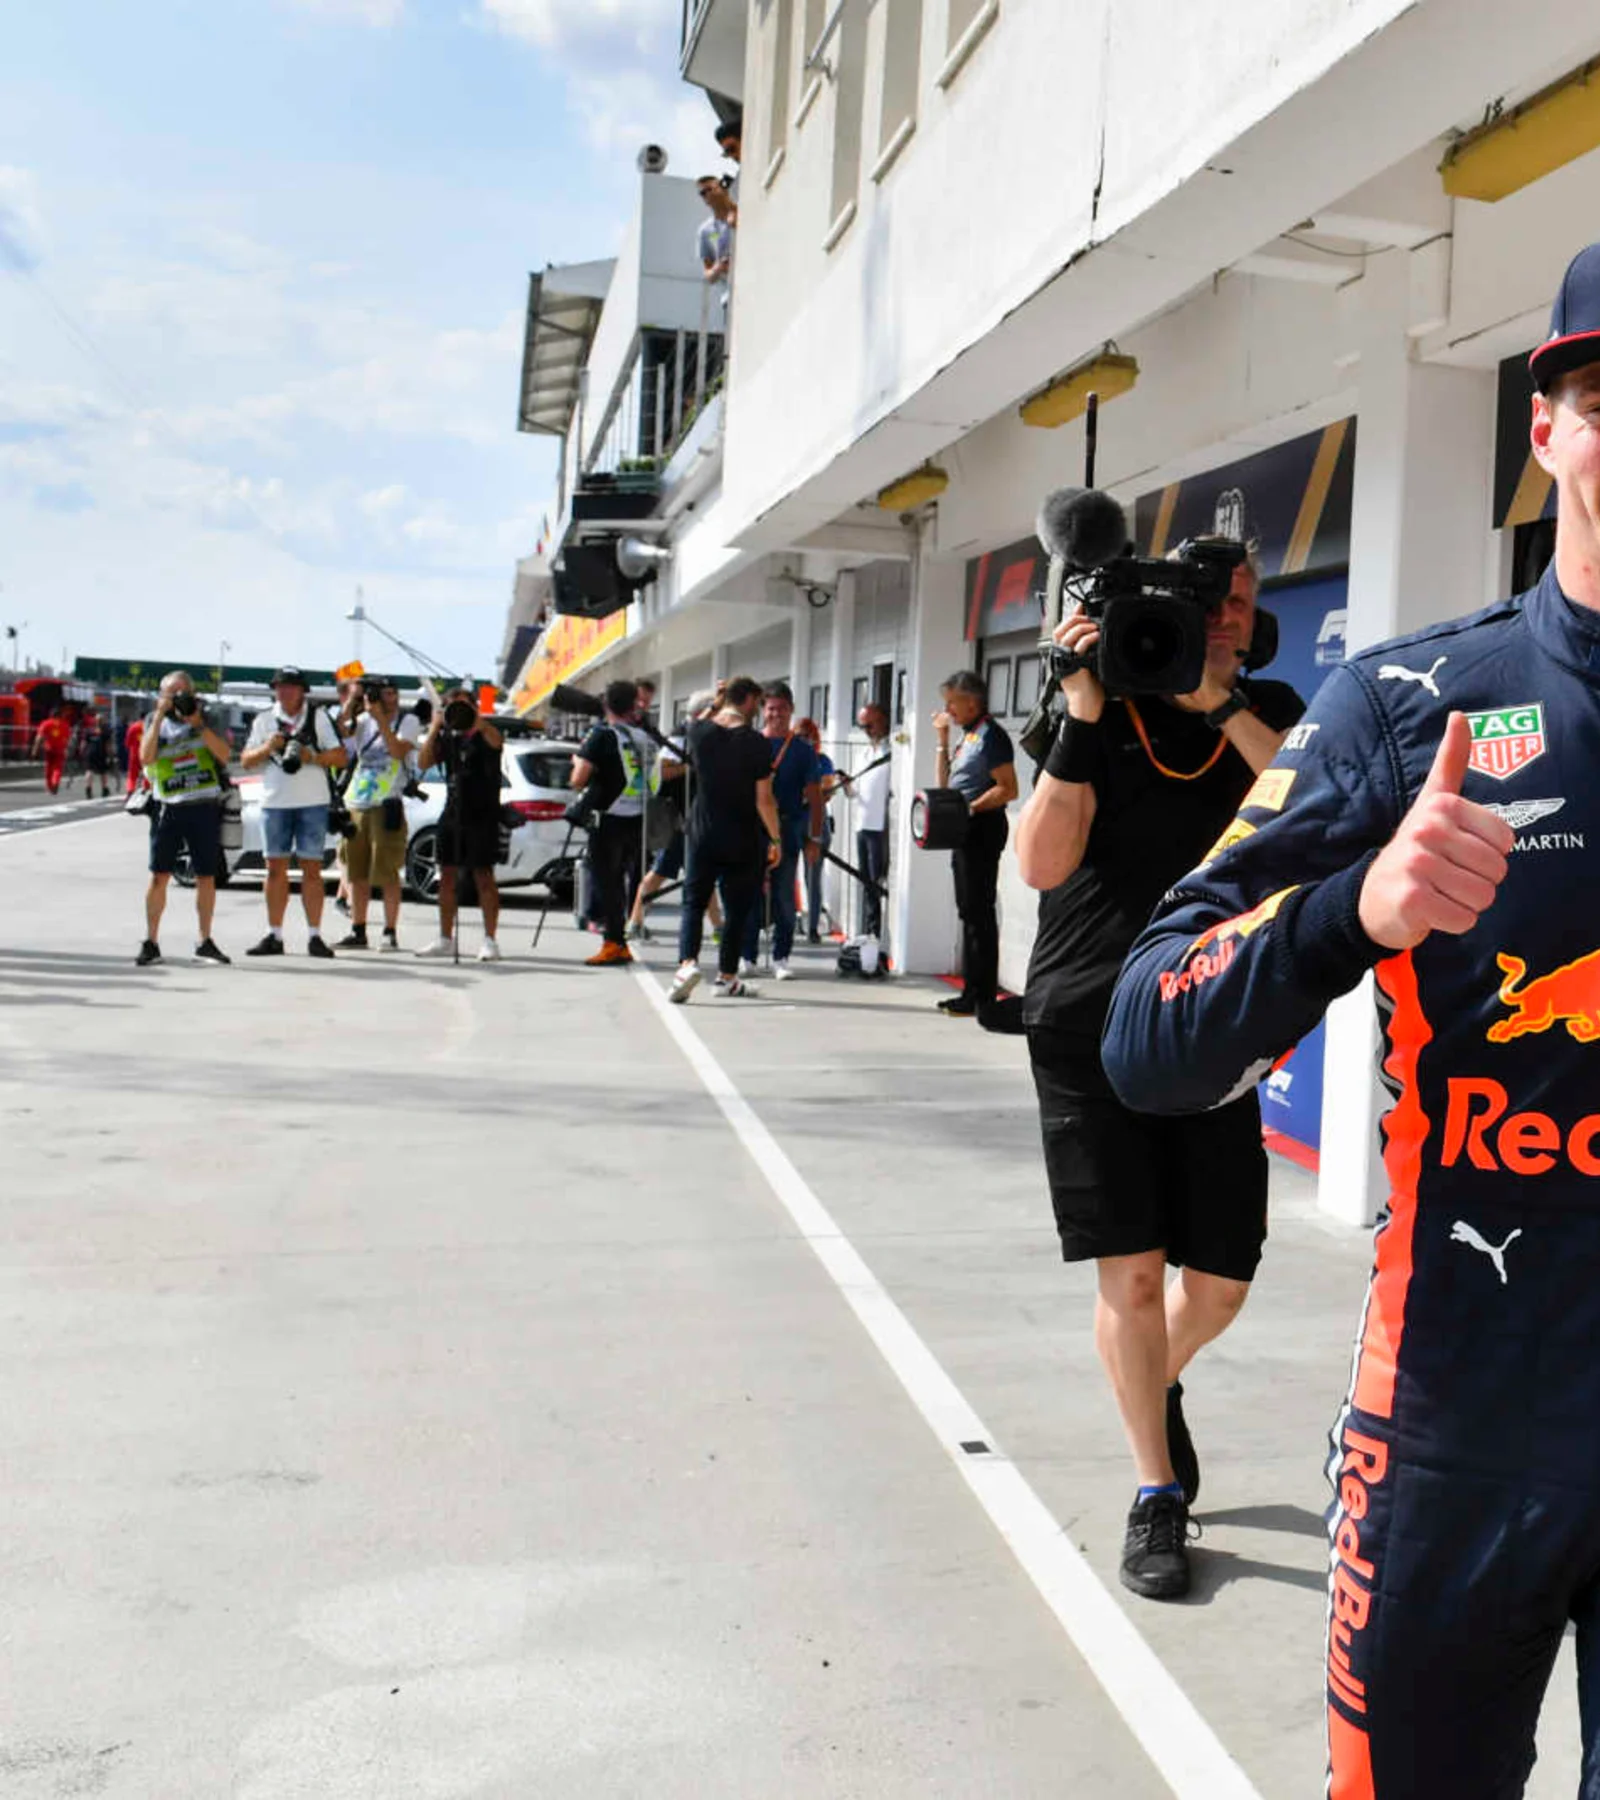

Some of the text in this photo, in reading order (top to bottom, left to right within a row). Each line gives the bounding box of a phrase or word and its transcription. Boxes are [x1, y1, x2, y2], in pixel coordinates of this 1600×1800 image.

[1468, 710, 1534, 738] TAG
[1470, 737, 1538, 773] EUER
[1510, 833, 1584, 852] MARTIN
